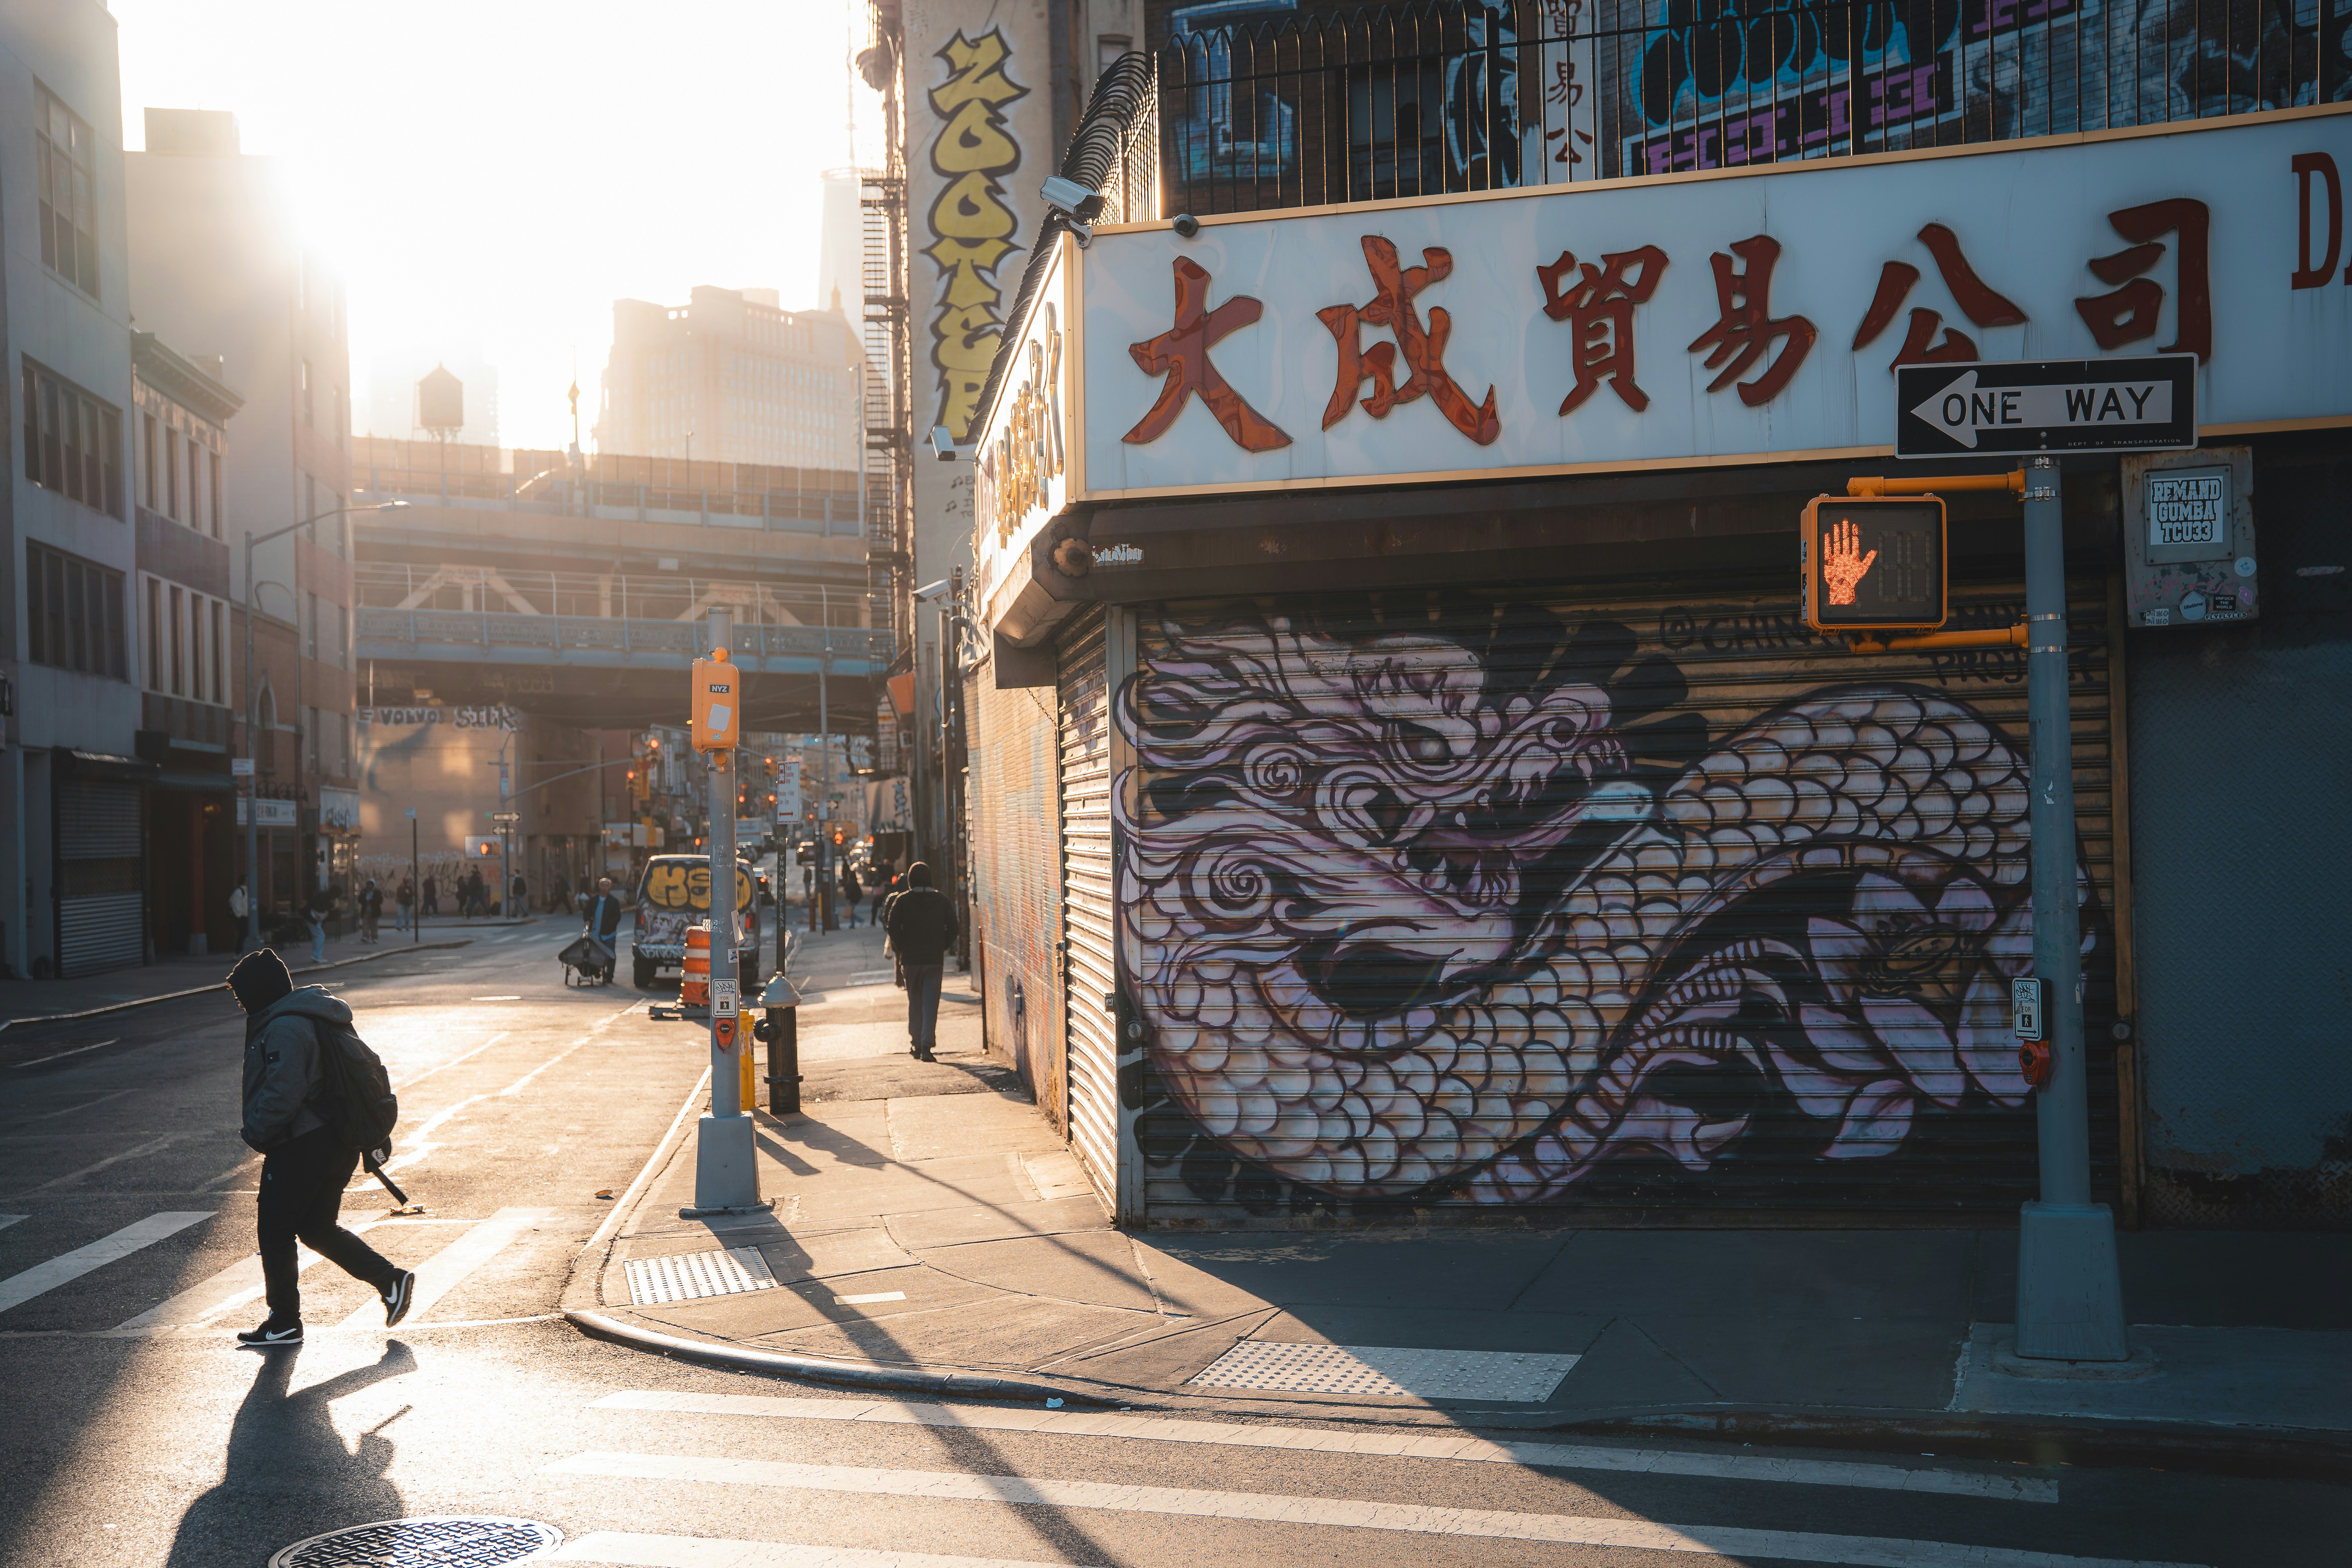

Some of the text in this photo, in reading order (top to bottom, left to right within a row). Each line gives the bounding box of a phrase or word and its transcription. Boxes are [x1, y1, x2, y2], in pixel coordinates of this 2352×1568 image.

[1121, 198, 2212, 452] 大成貿易公司
[1942, 386, 2155, 427] ONE WAY
[2152, 478, 2222, 503] REMAND
[2157, 501, 2216, 522] GUMBA
[2162, 521, 2213, 543] TCU33
[1916, 646, 2100, 686] PROJT
